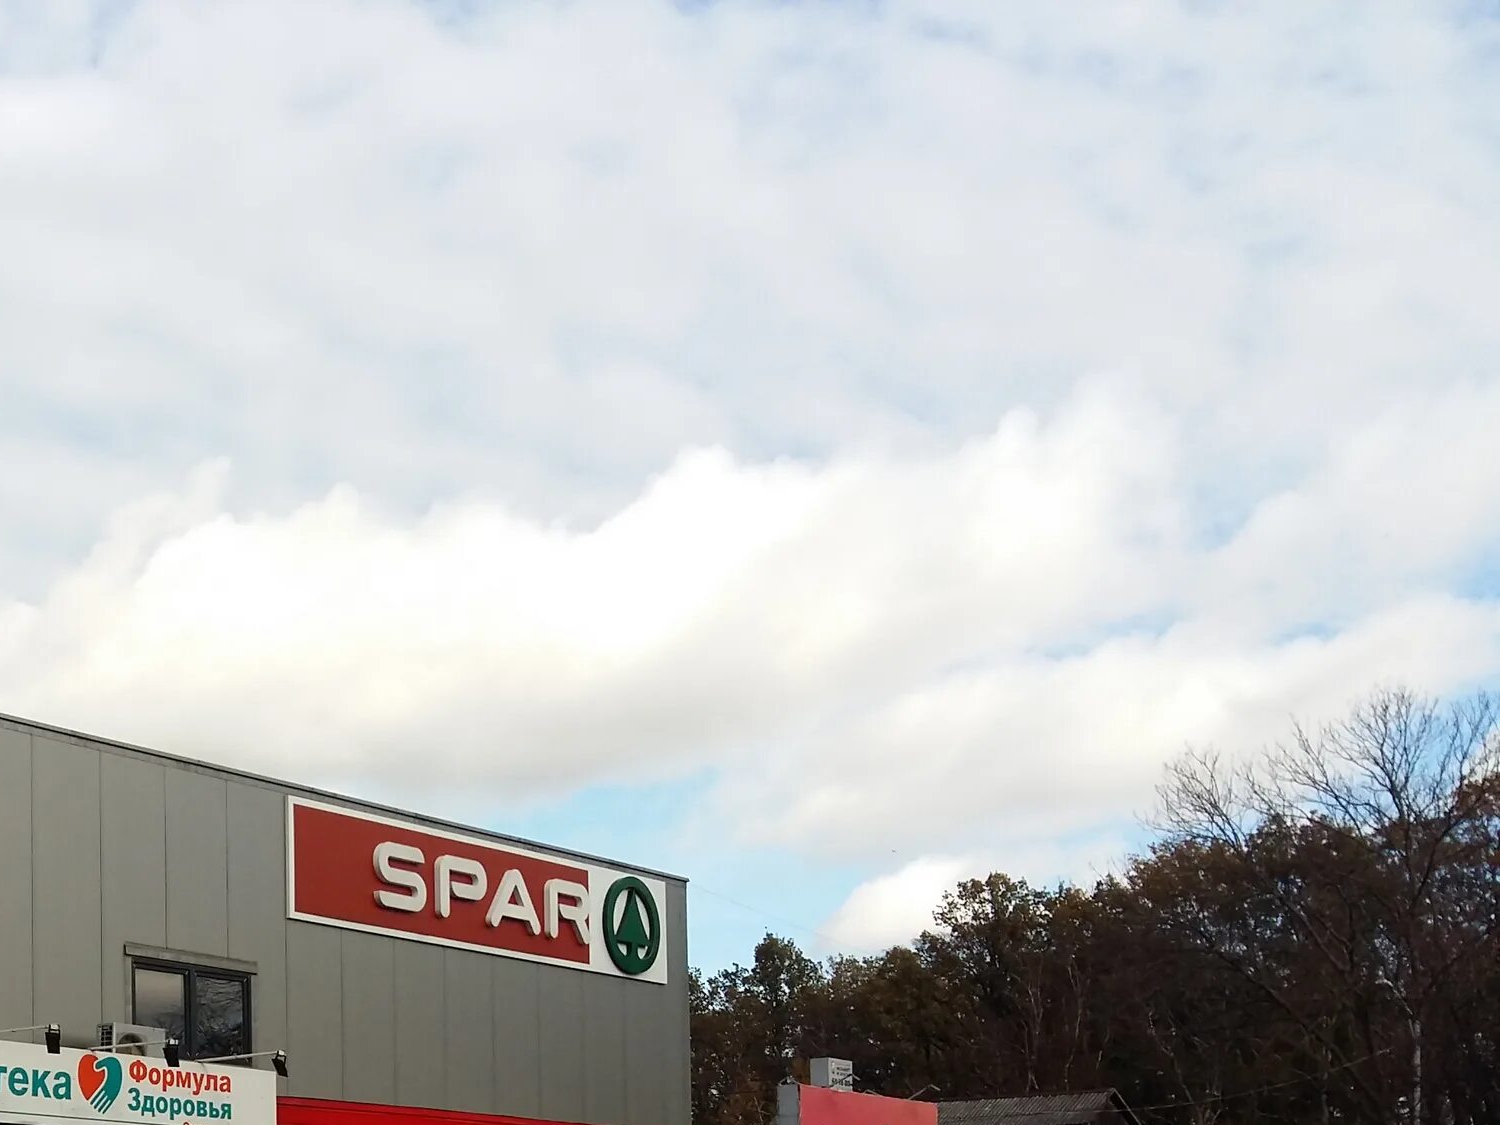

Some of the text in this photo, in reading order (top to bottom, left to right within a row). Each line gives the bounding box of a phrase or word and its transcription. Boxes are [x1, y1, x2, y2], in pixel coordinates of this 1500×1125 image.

[373, 841, 591, 945] SPAR
[128, 1060, 232, 1096] Формула
[127, 1087, 232, 1120] Здоровья
